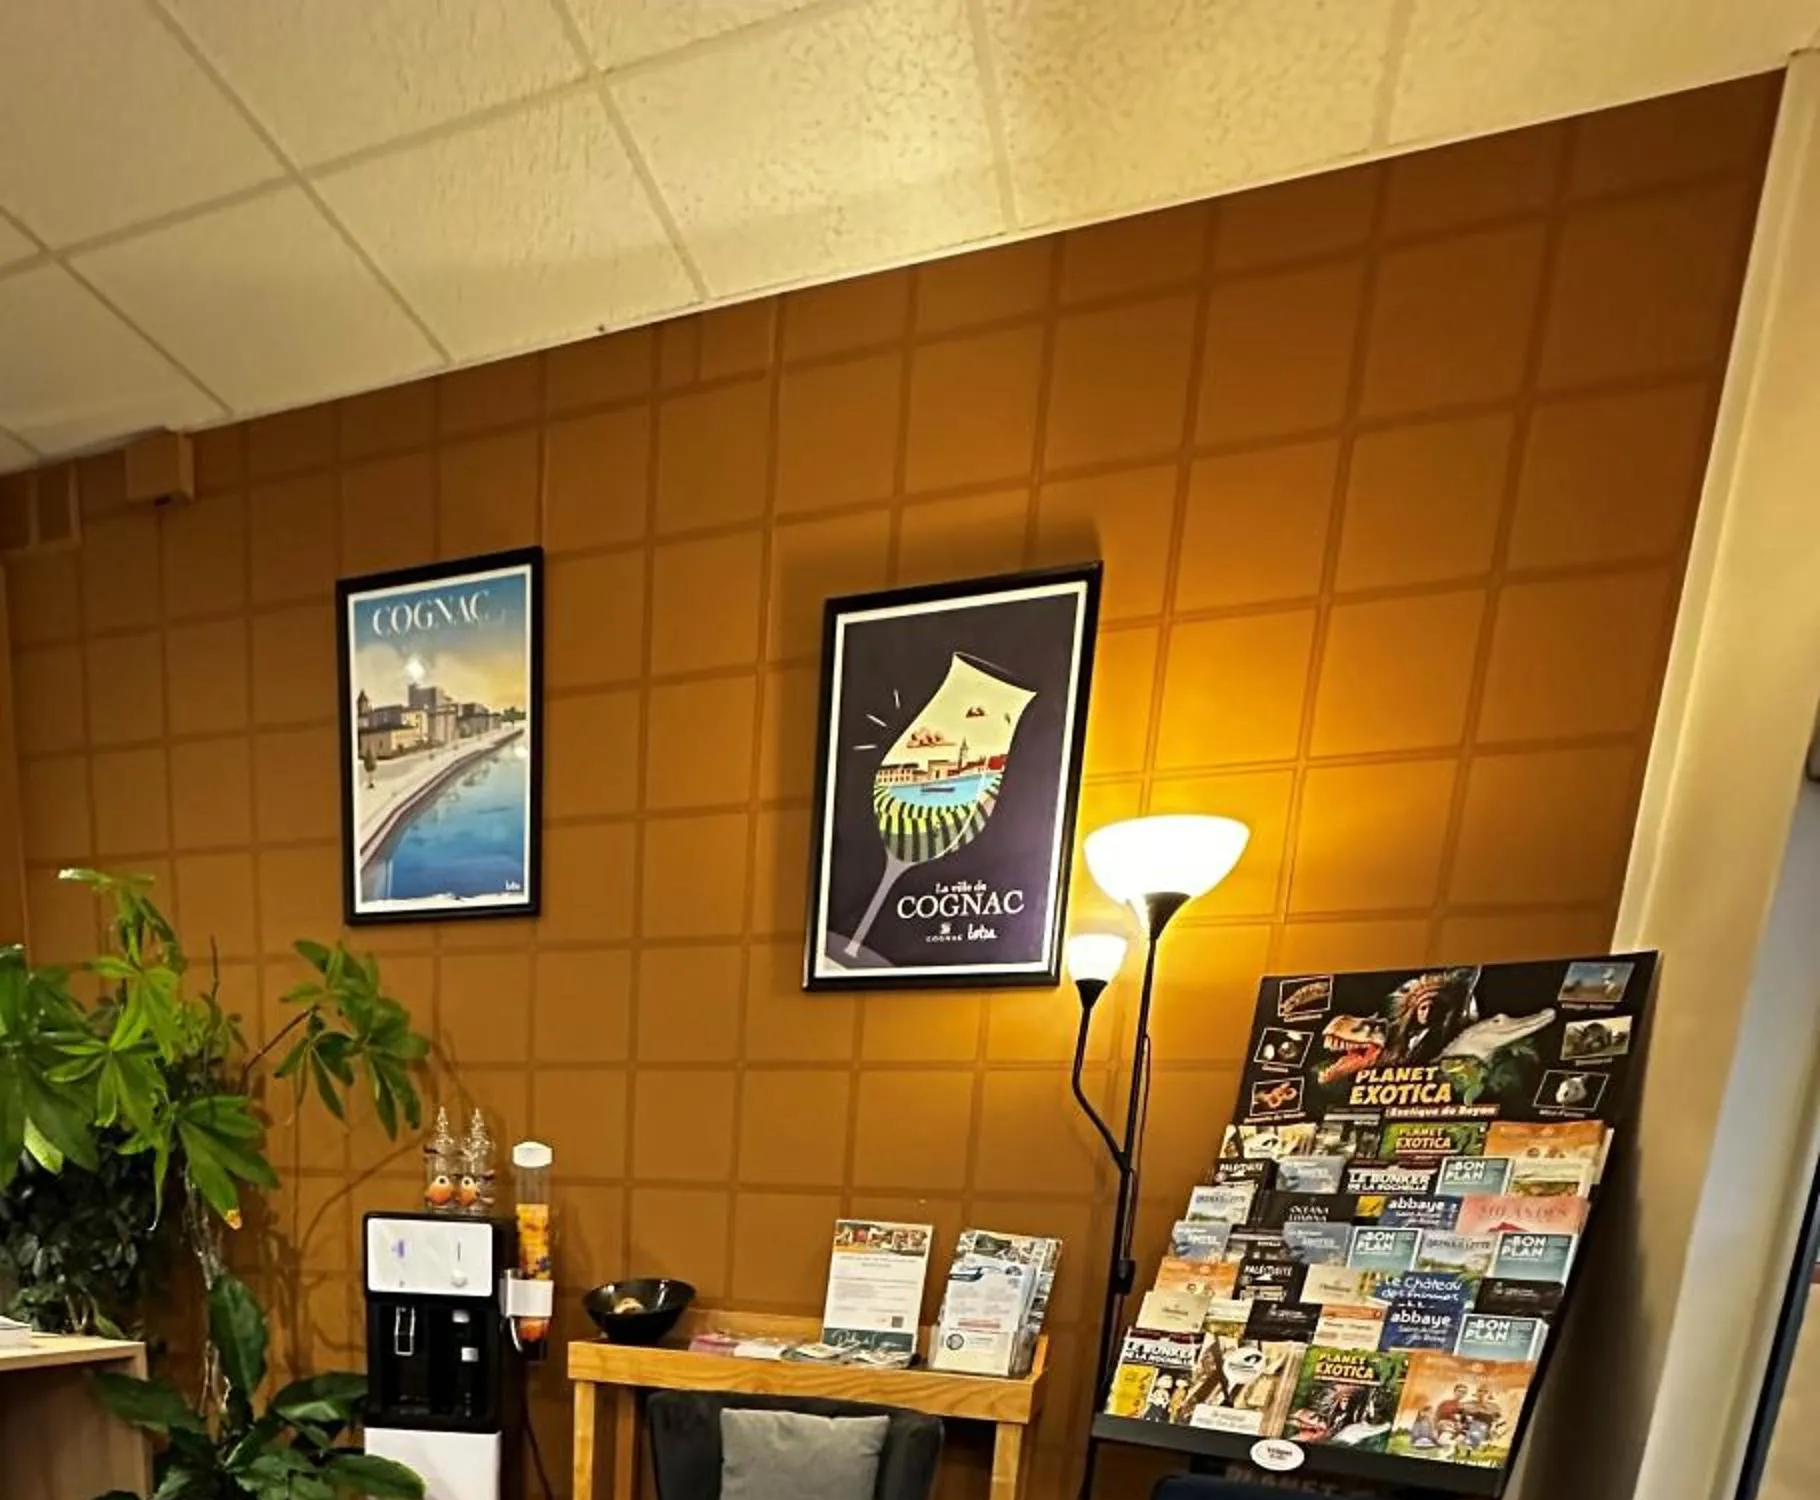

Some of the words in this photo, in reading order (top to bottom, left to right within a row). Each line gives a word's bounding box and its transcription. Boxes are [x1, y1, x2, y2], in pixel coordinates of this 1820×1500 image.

[372, 589, 489, 637] COGNAC
[897, 890, 1025, 919] COGNAC
[1355, 1066, 1439, 1083] PLANET
[1349, 1083, 1452, 1105] EXOTICA
[1400, 1129, 1443, 1137] PLANET
[1395, 1137, 1451, 1149] EXOTICA
[1455, 1161, 1485, 1171] BON
[1369, 1172, 1431, 1185] BUNKER
[1445, 1171, 1483, 1181] PLAN
[1387, 1196, 1445, 1213] abbaye
[1364, 1232, 1396, 1242] BON
[1512, 1236, 1546, 1247] BON
[1357, 1241, 1393, 1251] PLAN
[1501, 1246, 1544, 1257] PLAN
[1404, 1275, 1462, 1291] Château
[1390, 1309, 1451, 1329] abbaye
[1477, 1319, 1511, 1331] BON
[1464, 1330, 1508, 1341] PLAN
[1318, 1353, 1367, 1366] PLANET
[1314, 1362, 1375, 1380] EXOTICA
